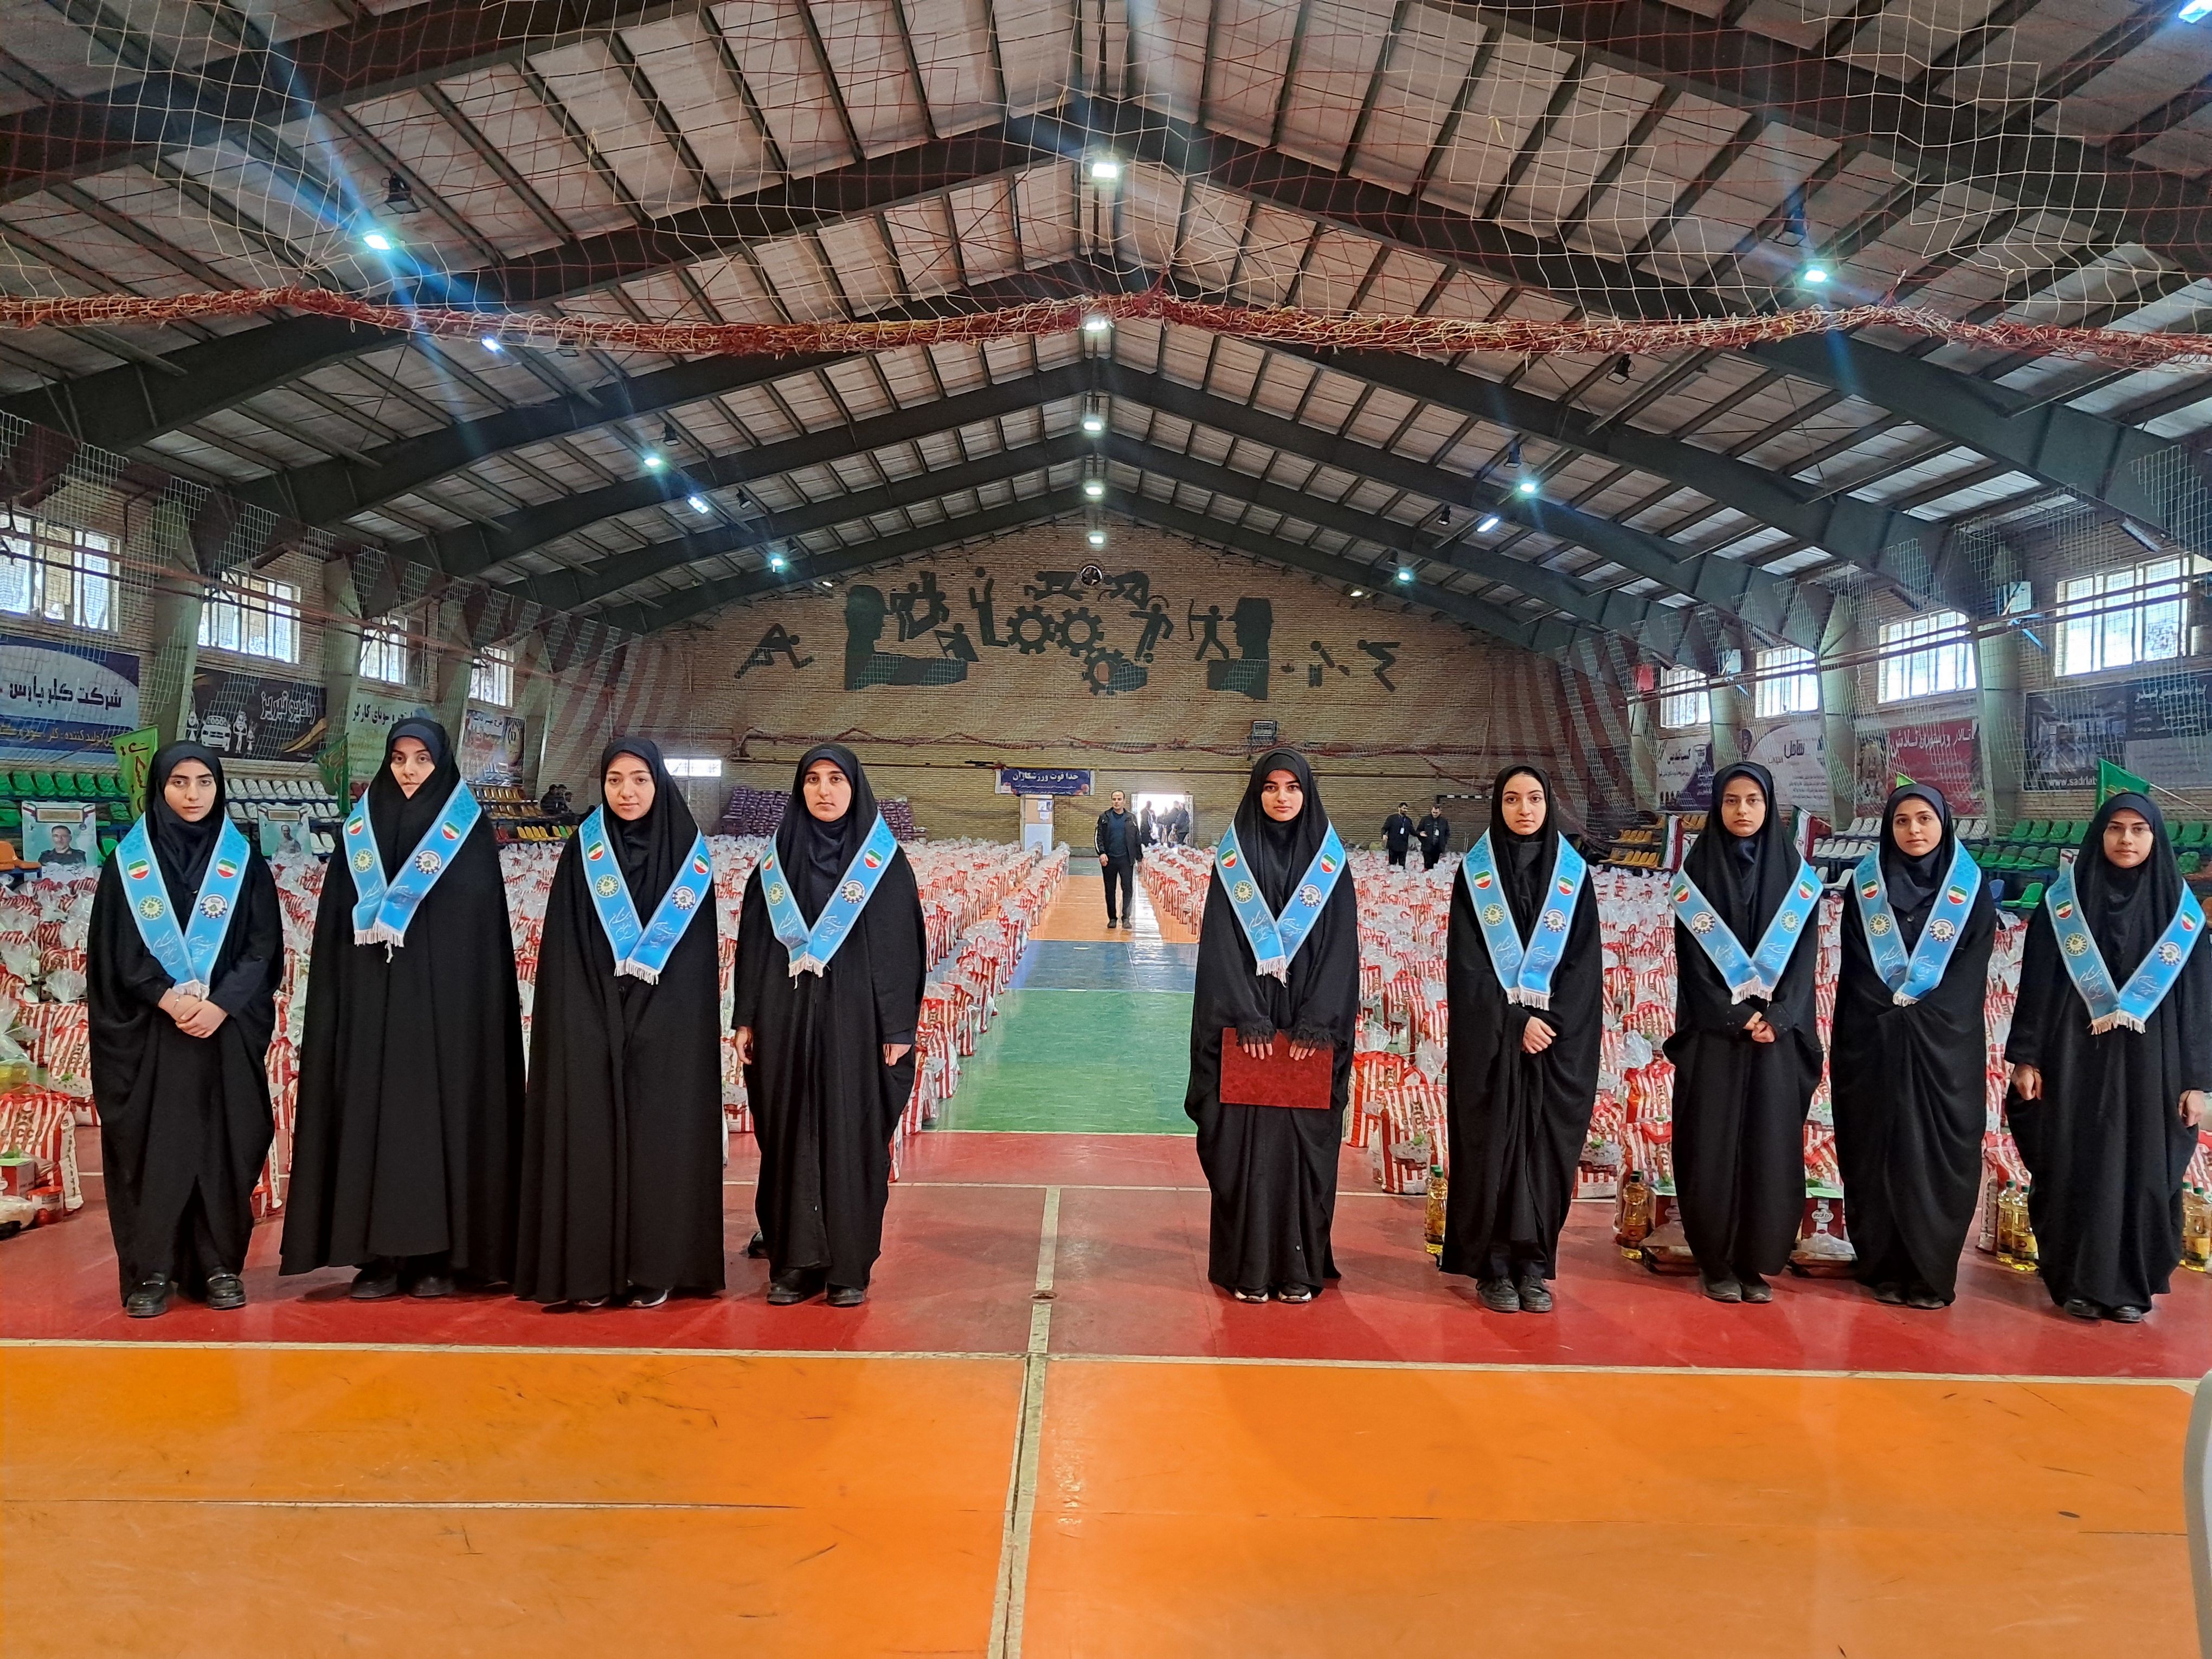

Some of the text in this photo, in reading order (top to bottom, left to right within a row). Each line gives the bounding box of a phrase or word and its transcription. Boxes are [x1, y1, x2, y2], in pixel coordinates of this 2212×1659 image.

[9, 675, 44, 707] پارس
[77, 687, 122, 710] شرکت
[1050, 771, 1064, 782] قوت
